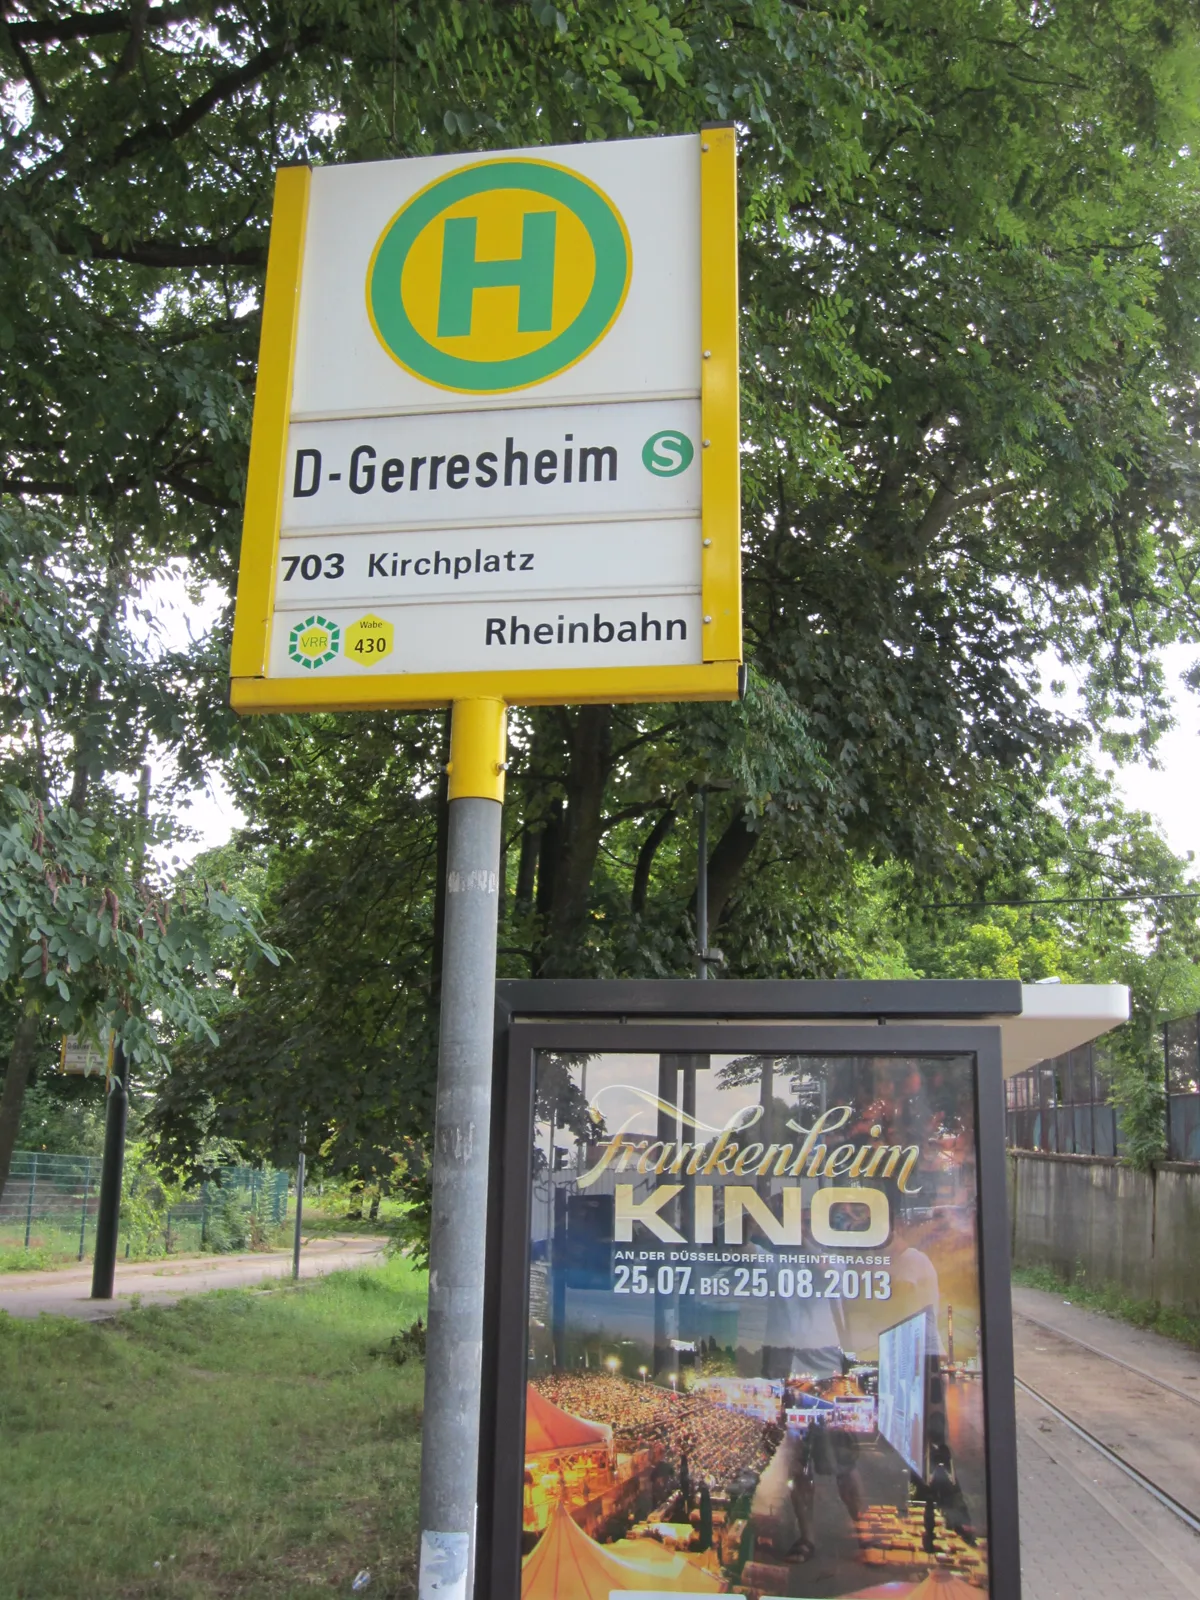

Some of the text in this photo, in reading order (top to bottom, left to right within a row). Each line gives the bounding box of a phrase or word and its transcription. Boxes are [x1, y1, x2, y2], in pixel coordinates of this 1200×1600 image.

[437, 211, 557, 338] H
[293, 434, 685, 498] D-Gerresheim S
[281, 549, 535, 582] 703 Kirchplatz
[359, 620, 383, 629] Wabe
[486, 612, 688, 646] Rheinbahn
[301, 636, 328, 648] VRR
[354, 637, 386, 654] 430
[614, 1184, 891, 1248] KINO
[615, 1250, 891, 1265] AN DER DÜSSELDORFER RHEINTERRASSE
[614, 1265, 892, 1300] 25.07. BIS 25.08.2013
